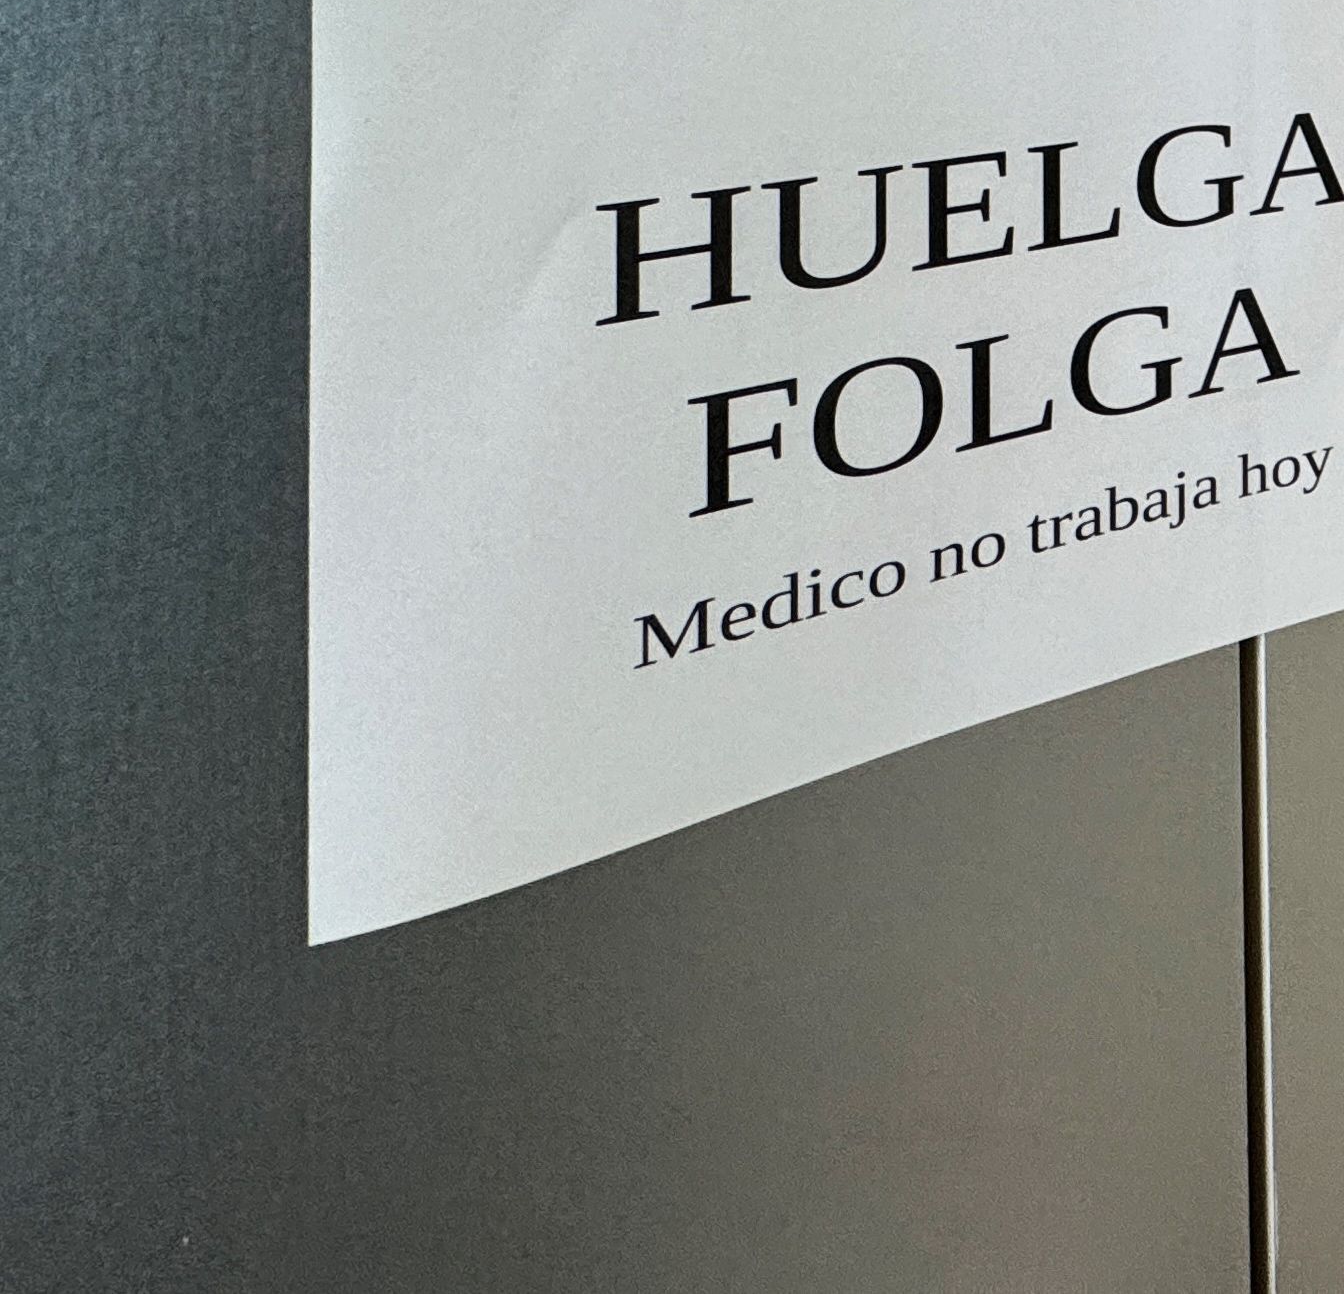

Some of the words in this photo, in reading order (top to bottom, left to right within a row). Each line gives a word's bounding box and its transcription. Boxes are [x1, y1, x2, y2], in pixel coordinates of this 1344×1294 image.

[687, 288, 1300, 518] FOLGA
[634, 568, 906, 670] Medico
[930, 533, 1006, 583] no
[1027, 471, 1220, 554] trabaja
[1238, 446, 1334, 498] hoy
